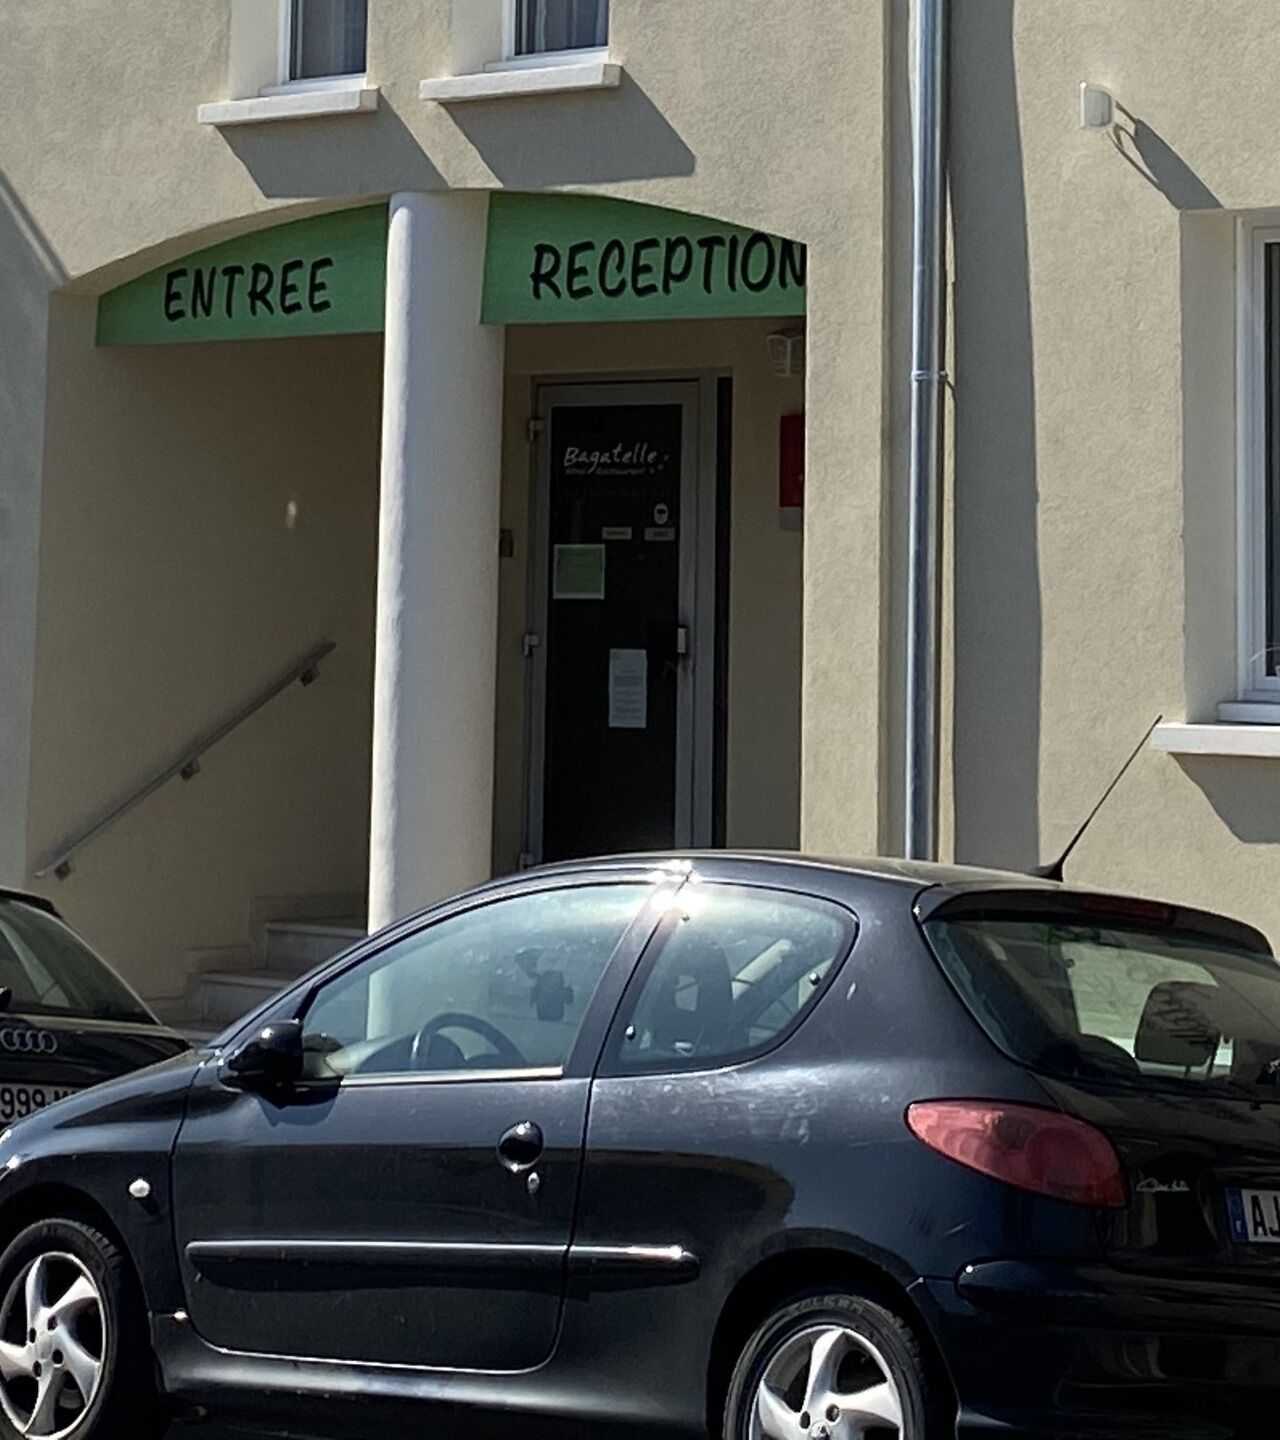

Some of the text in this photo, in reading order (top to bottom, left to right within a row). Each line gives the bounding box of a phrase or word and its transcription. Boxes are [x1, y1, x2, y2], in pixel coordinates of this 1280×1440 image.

[163, 256, 334, 323] ENTREE
[529, 231, 807, 301] RECEPTION
[563, 442, 658, 474] Bagatelle
